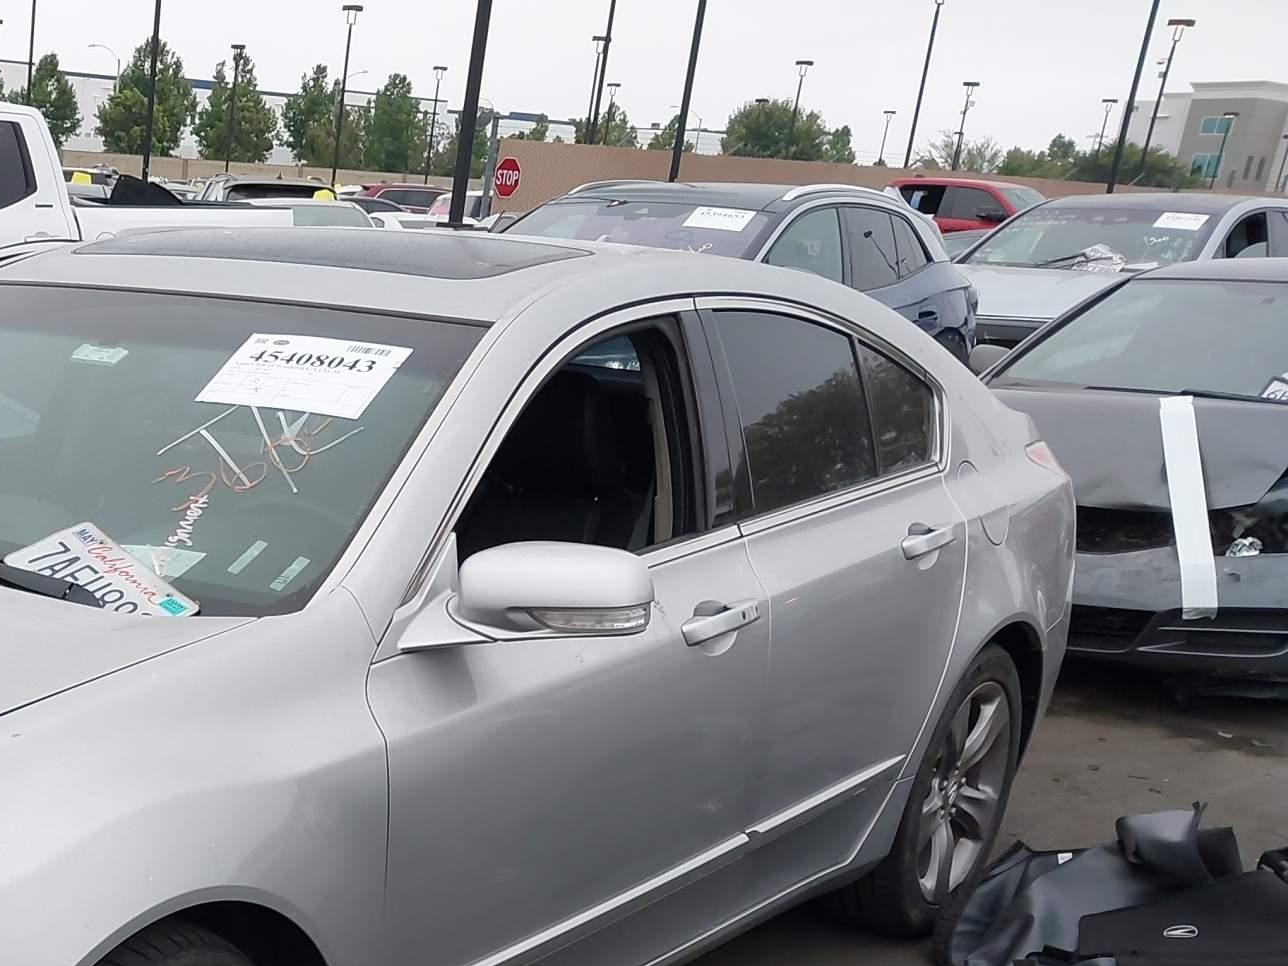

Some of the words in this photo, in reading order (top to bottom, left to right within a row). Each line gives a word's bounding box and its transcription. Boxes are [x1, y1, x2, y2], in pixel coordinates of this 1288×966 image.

[495, 169, 519, 186] STOP
[249, 350, 377, 373] 45408043
[77, 528, 98, 548] MAY
[87, 544, 160, 606] California
